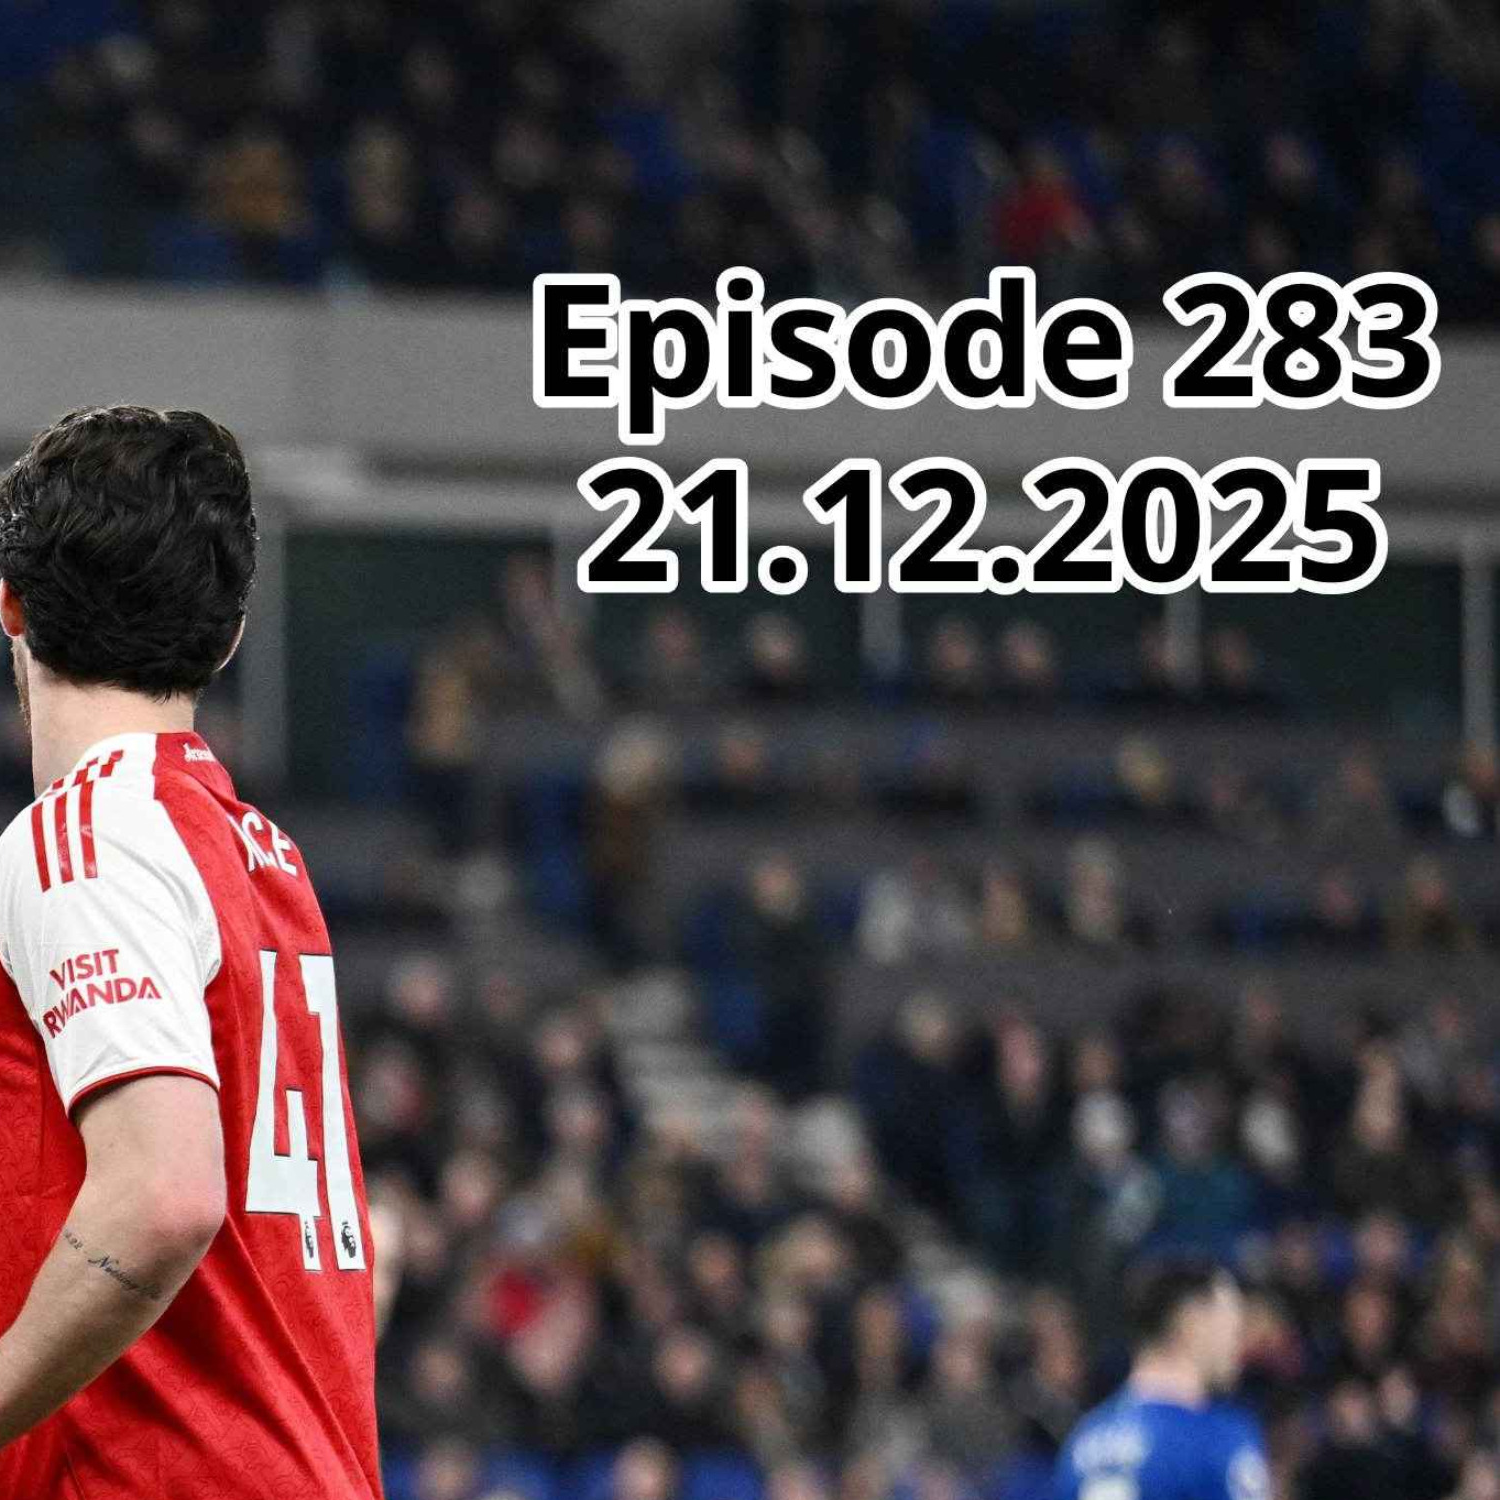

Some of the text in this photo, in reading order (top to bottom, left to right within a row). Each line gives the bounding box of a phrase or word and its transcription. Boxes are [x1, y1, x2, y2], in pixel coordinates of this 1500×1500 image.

[49, 948, 120, 991] VISIT
[42, 976, 163, 1039] RWANDA
[244, 949, 366, 1272] 41
